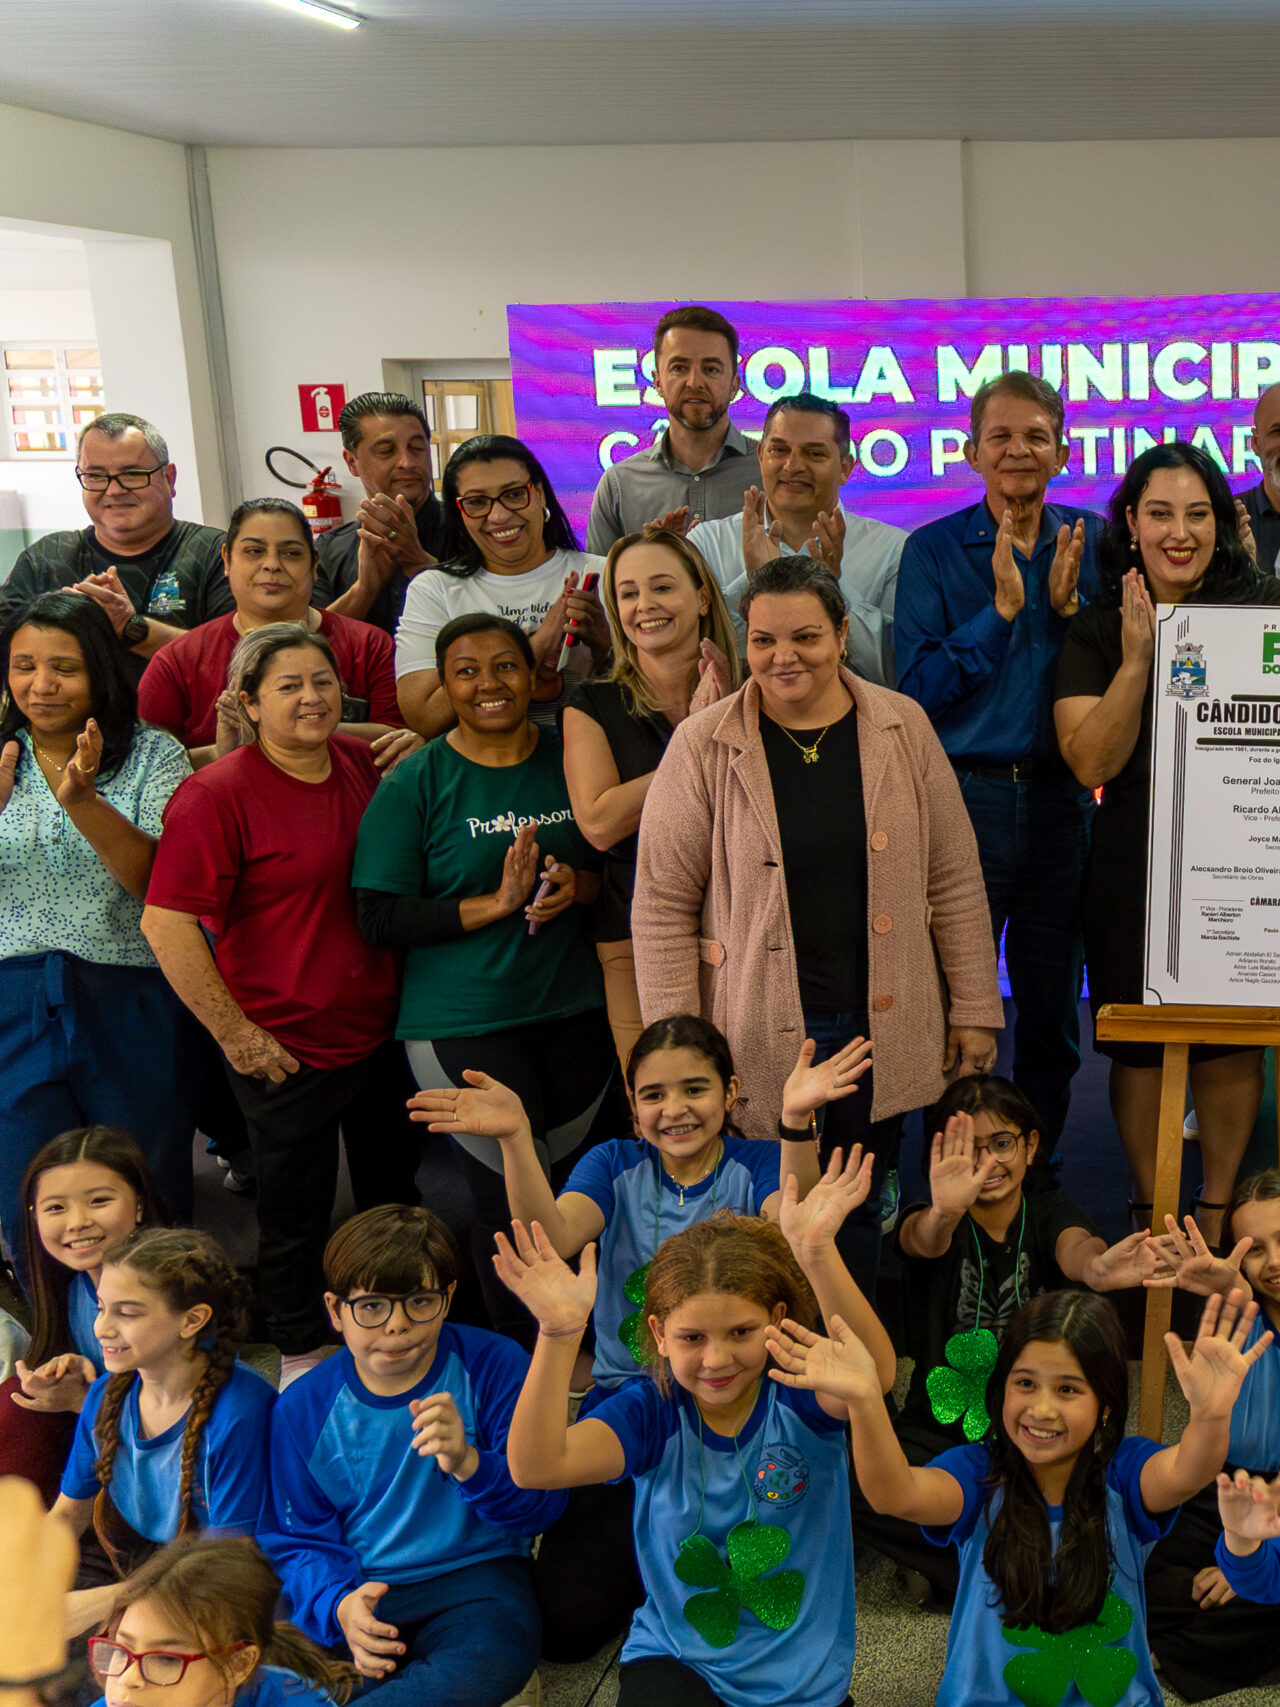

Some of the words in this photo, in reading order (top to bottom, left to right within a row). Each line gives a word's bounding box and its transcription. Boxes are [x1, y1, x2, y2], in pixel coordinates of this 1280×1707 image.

[594, 346, 914, 406] EOLA
[1213, 726, 1242, 736] ESCOLA
[1222, 775, 1261, 785] General
[1250, 787, 1280, 795] Prefeito
[1232, 804, 1270, 814] Ricardo
[1248, 836, 1271, 844] Joyce
